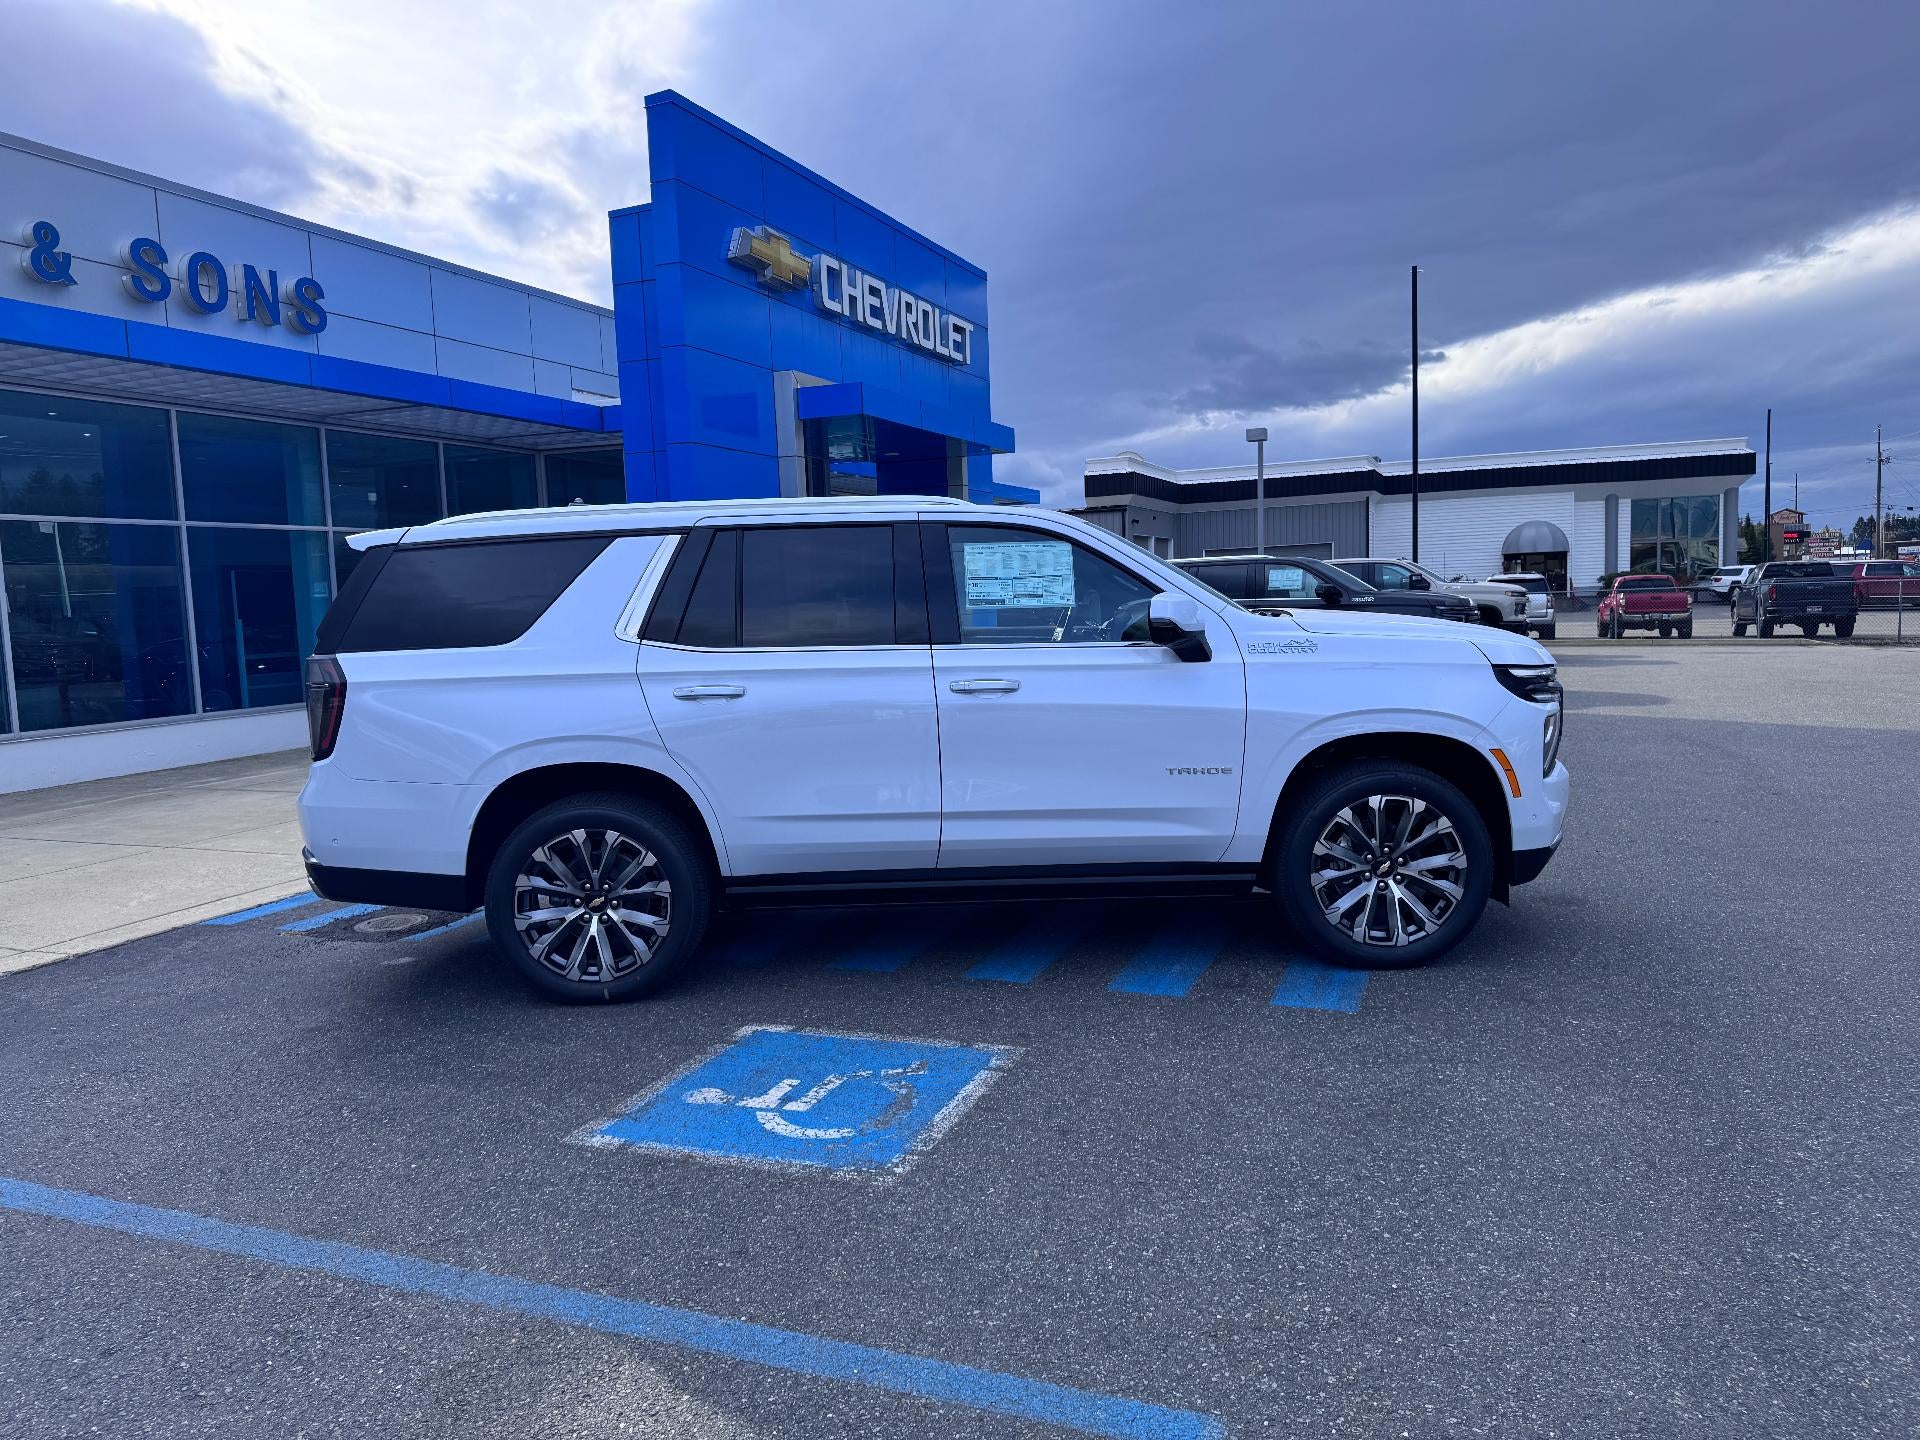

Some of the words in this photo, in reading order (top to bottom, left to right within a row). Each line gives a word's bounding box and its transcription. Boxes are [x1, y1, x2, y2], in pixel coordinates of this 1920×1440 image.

[21, 220, 78, 286] &
[119, 237, 328, 335] SONS
[813, 253, 974, 365] CHEVROLET
[1247, 647, 1319, 655] COUNTRY
[1165, 766, 1233, 776] TAHOE
